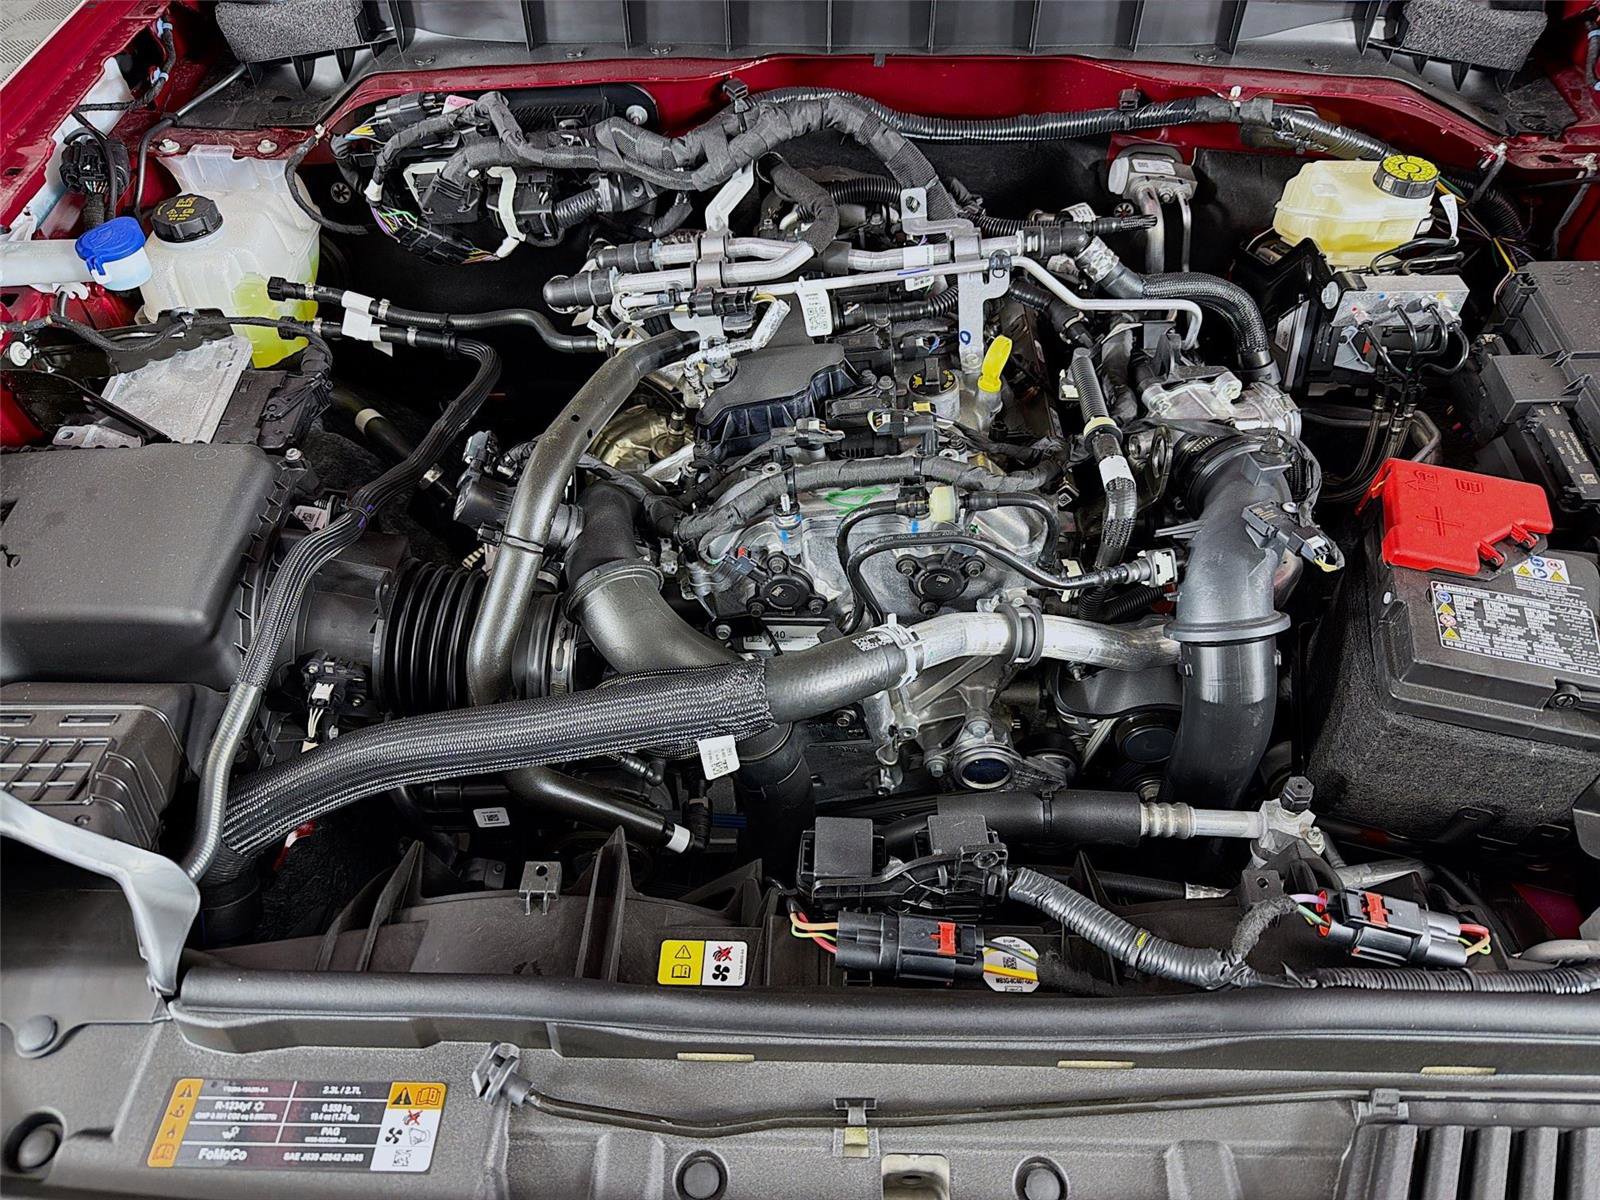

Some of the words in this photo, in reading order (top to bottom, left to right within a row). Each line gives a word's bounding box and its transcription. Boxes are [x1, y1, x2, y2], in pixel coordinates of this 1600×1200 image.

[322, 1085, 339, 1094] 2.3L
[344, 1086, 361, 1095] 2.7L
[214, 1100, 252, 1112] R-1234yf
[320, 1126, 341, 1136] PAG
[198, 1147, 248, 1161] FoMoCo
[283, 1151, 301, 1161] SAE
